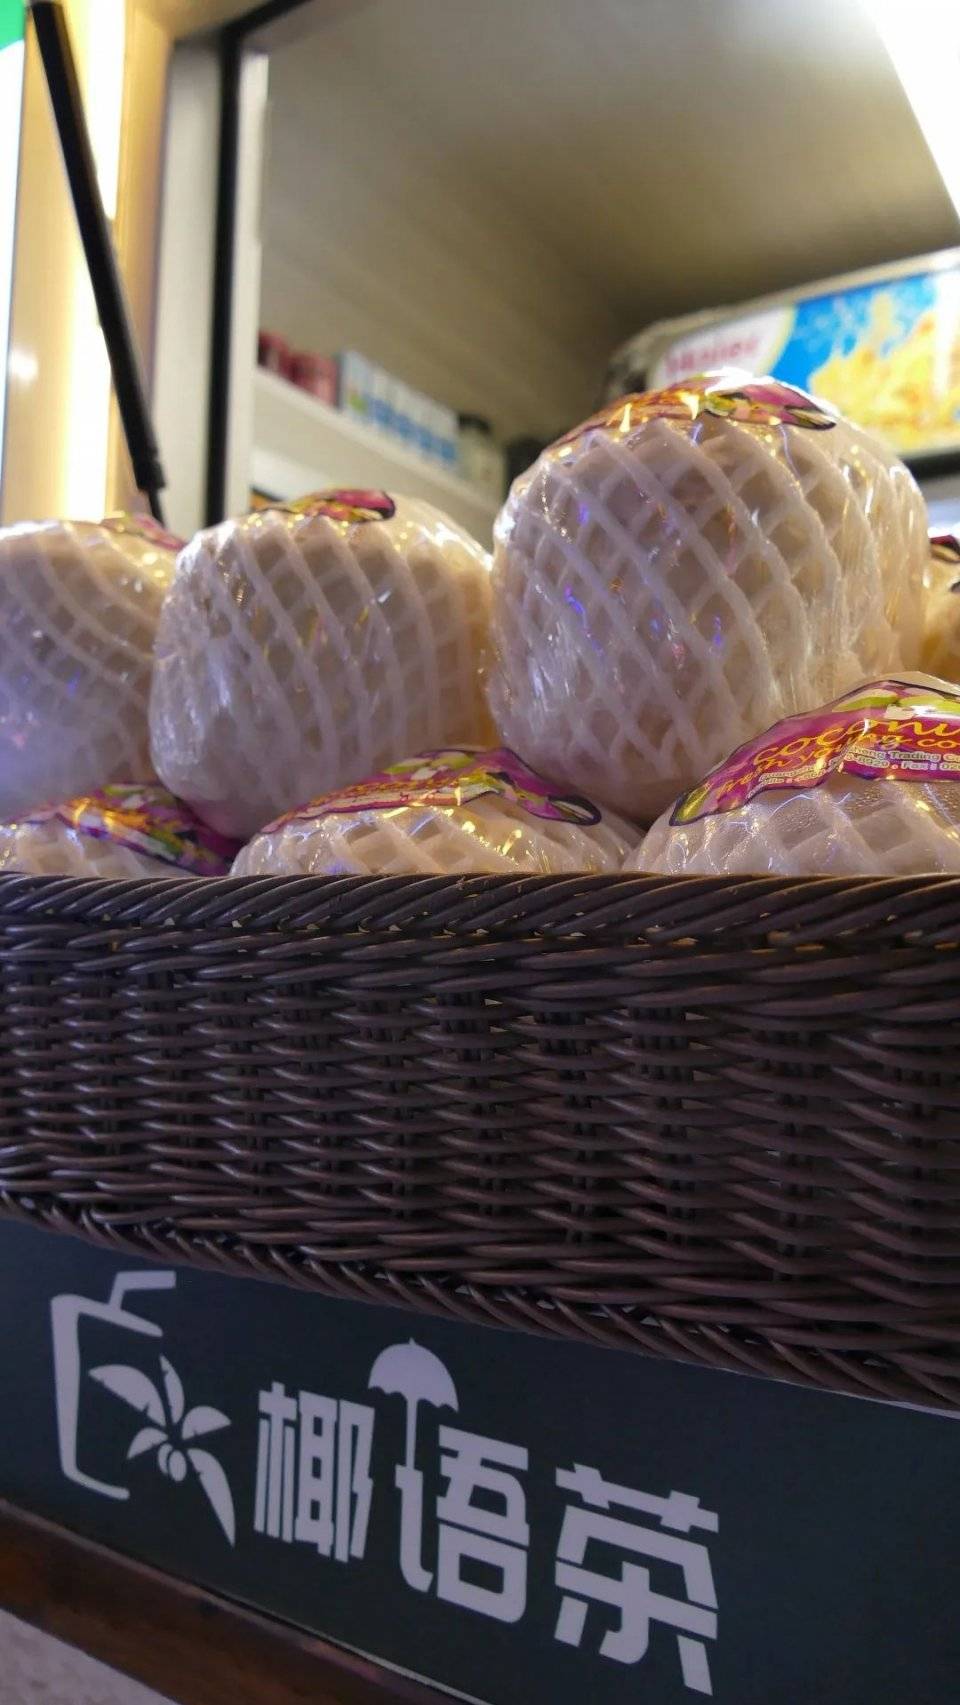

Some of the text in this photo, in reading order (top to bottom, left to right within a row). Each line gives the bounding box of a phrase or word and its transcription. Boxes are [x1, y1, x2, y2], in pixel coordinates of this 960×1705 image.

[888, 751, 941, 762] Trading
[254, 1380, 720, 1696] 椰语茶
